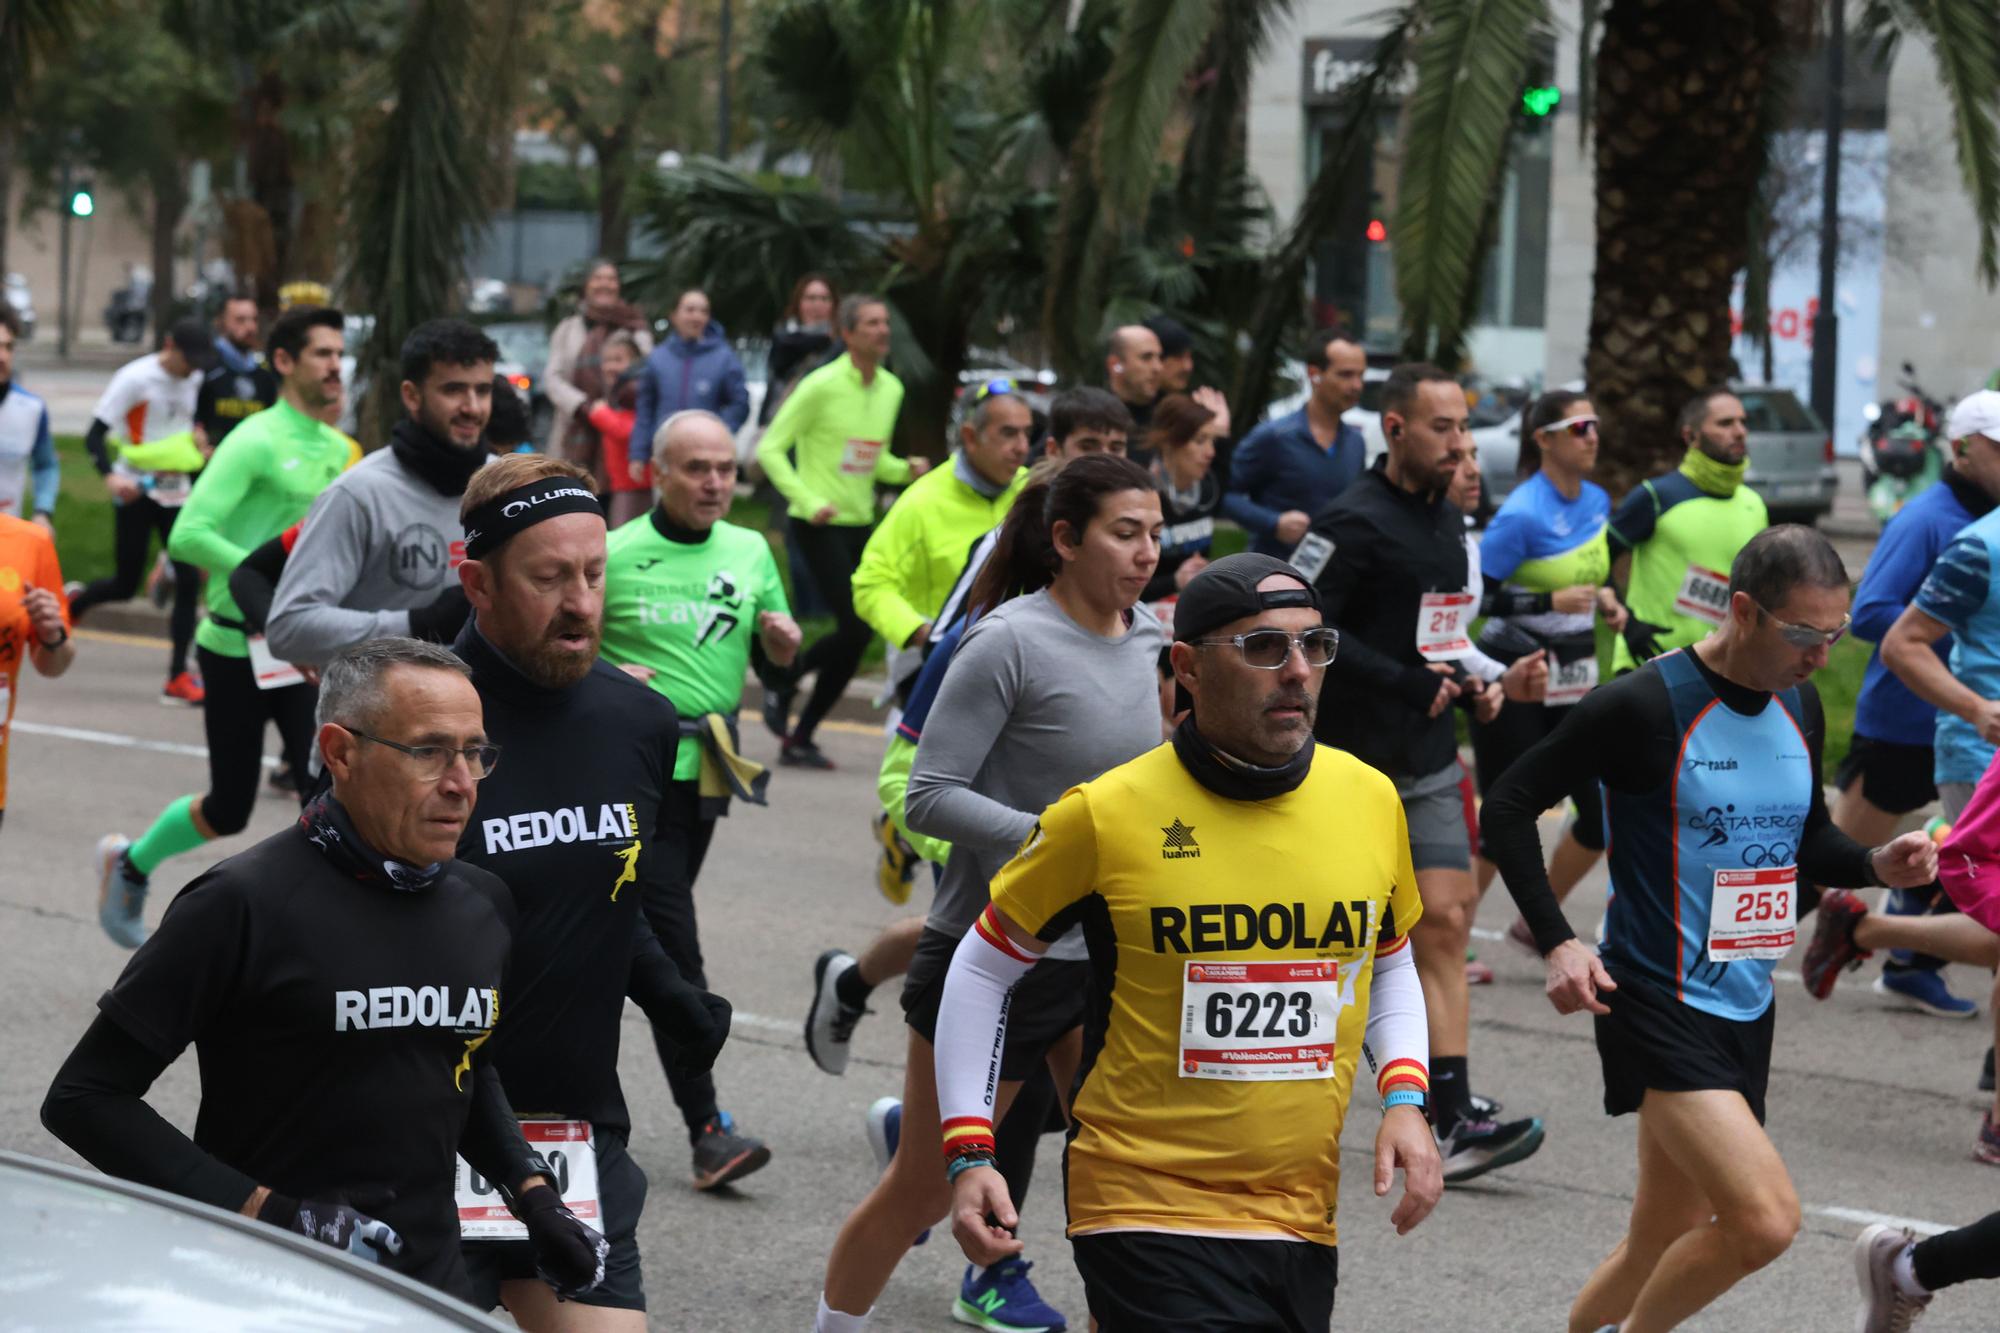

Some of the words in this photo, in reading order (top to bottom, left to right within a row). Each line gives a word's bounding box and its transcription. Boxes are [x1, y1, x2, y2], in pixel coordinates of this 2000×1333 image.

[482, 803, 633, 855] REDOLAT
[626, 803, 640, 836] TEAM
[1162, 848, 1200, 860] luanvi
[1150, 901, 1367, 954] REDOLAT
[1735, 890, 1789, 923] 253
[335, 985, 494, 1032] REDOLAT
[1205, 991, 1313, 1038] 6223
